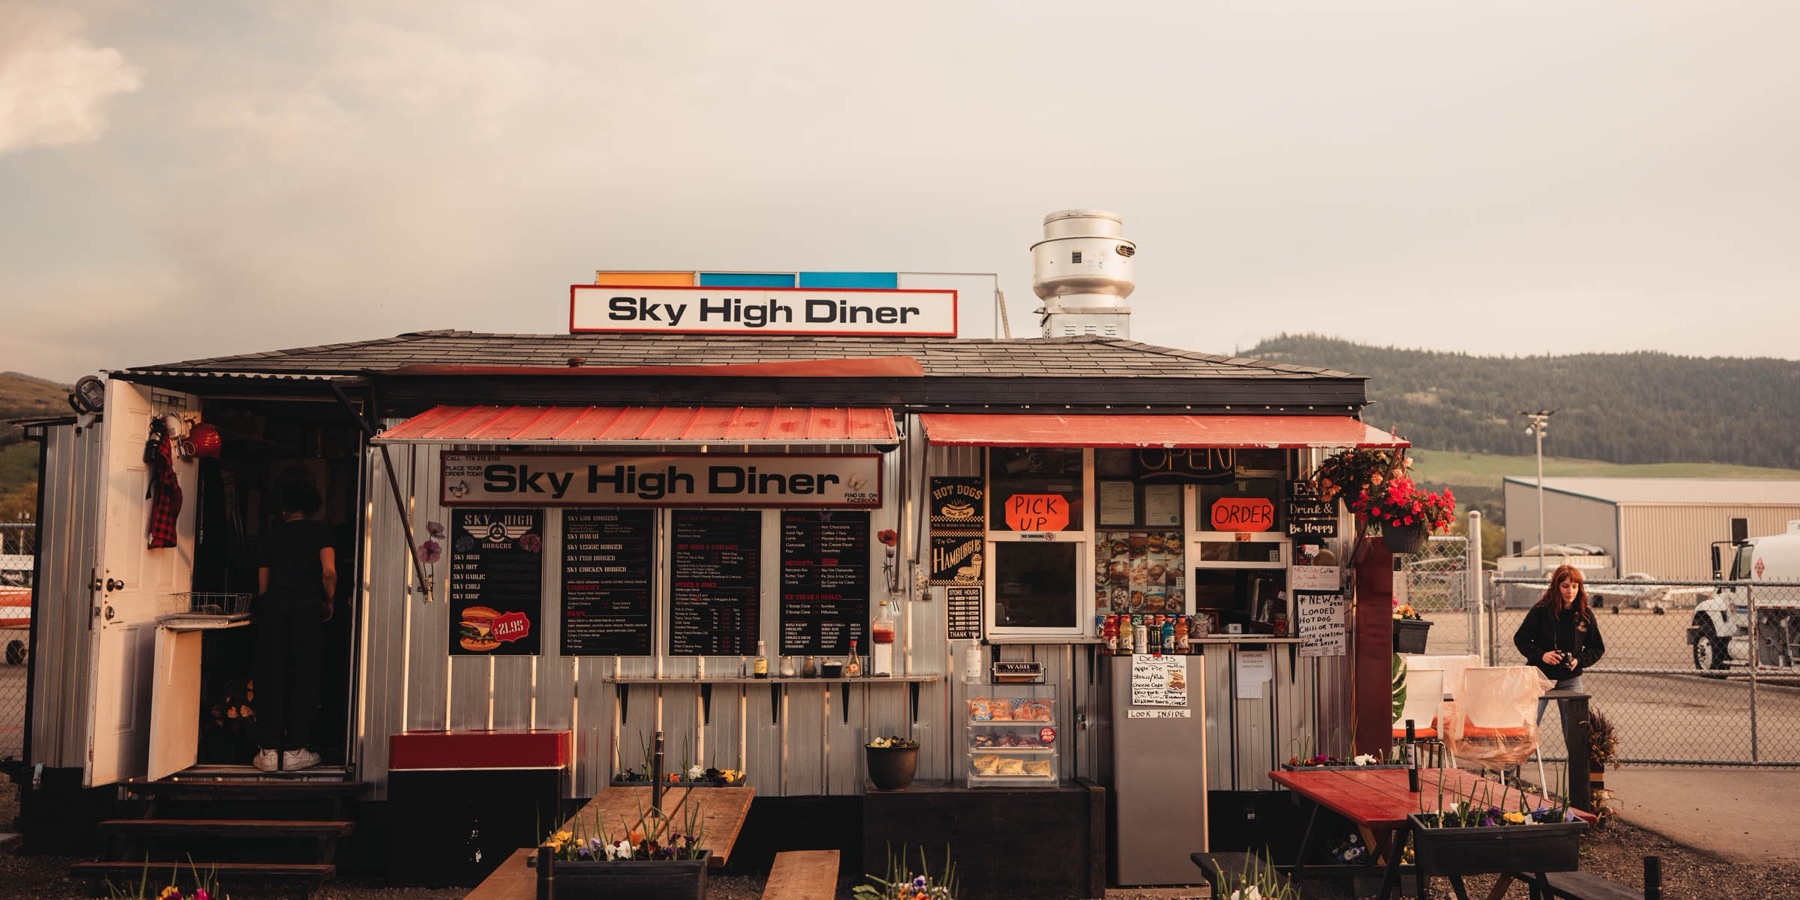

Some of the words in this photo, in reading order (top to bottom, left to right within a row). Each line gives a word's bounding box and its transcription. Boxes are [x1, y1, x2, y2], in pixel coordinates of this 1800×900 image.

[608, 297, 687, 327] Sky
[699, 298, 792, 328] High
[804, 300, 920, 325] Diner
[1138, 448, 1232, 470] OPEN
[483, 464, 574, 499] Sky
[587, 465, 695, 499] High
[708, 466, 840, 495] Diner
[933, 485, 954, 500] HOT
[956, 484, 983, 500] DOGS
[1015, 496, 1057, 515] PICK
[1290, 503, 1322, 515] Drink
[1323, 502, 1333, 514] &
[464, 514, 491, 526] SKY
[504, 514, 534, 526] HIGH
[1215, 505, 1271, 524] ORDER
[1020, 517, 1047, 531] UP
[1290, 523, 1302, 535] Be
[1304, 522, 1334, 535] Happy
[482, 542, 512, 550] BURGERS
[933, 539, 982, 574] HAMBURGERS
[1309, 595, 1331, 605] NEW
[1302, 607, 1335, 616] LOADED
[1299, 616, 1316, 625] HOT
[1317, 615, 1332, 623] DOG
[1131, 711, 1151, 719] LOOK
